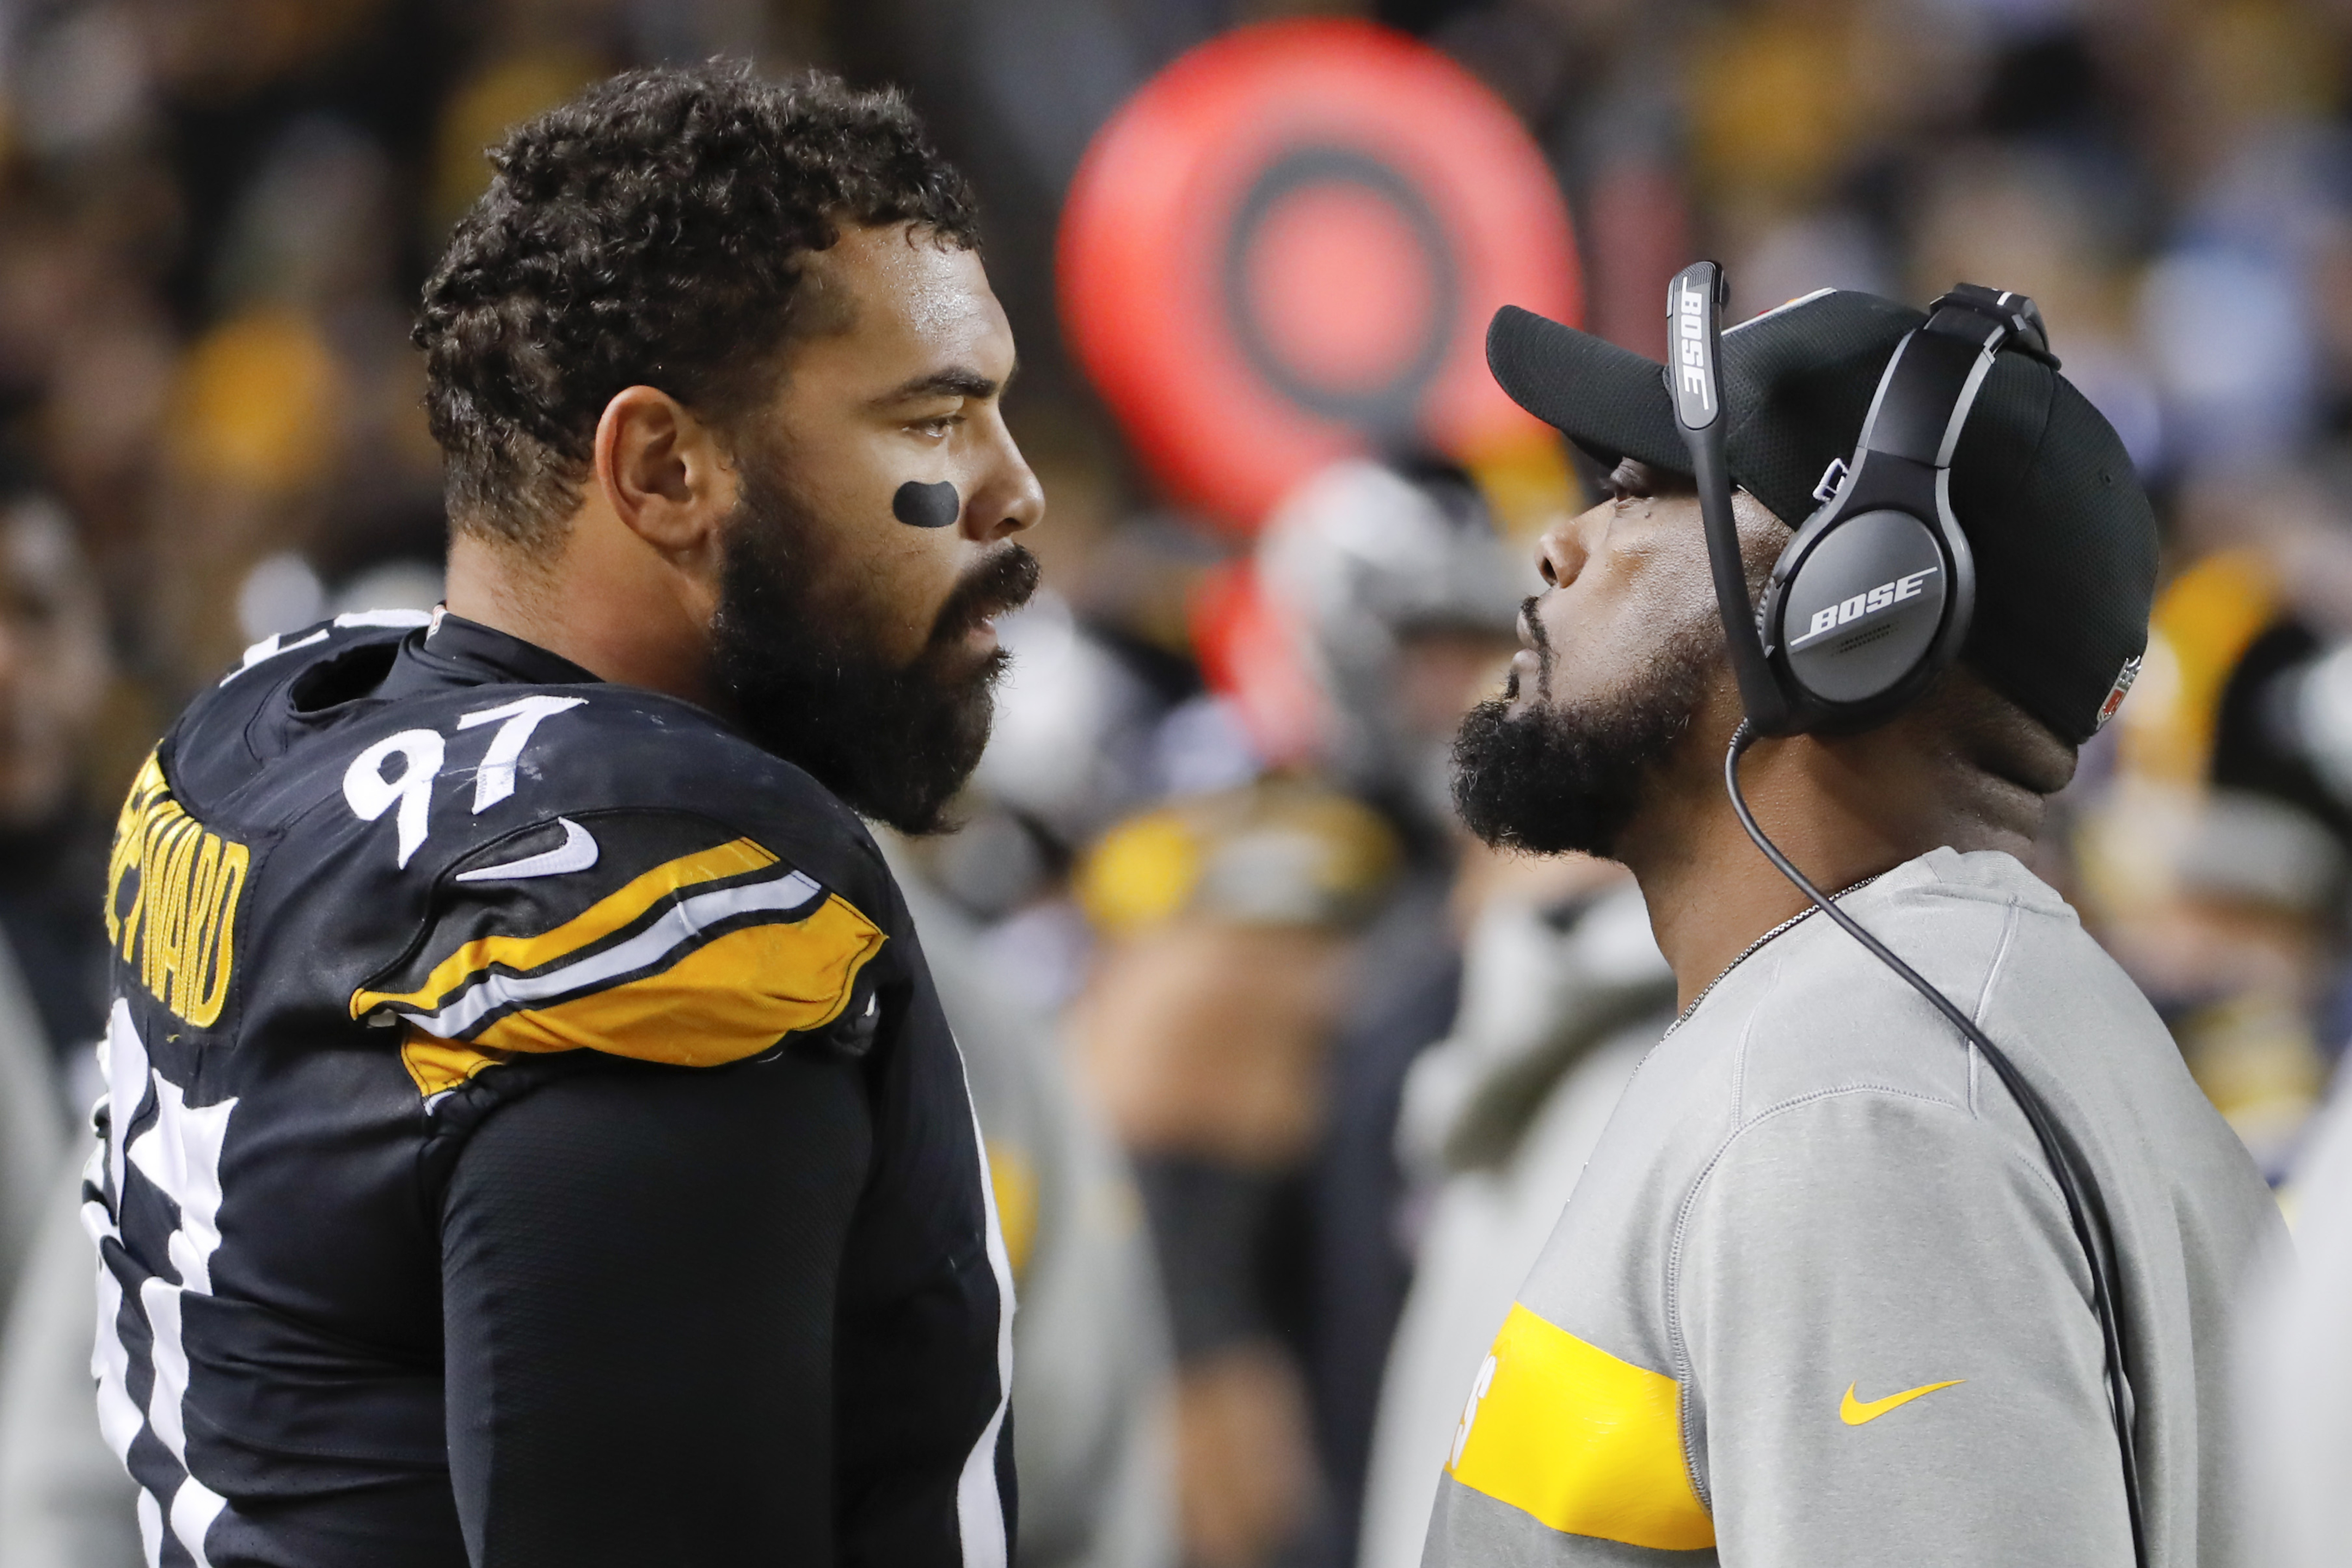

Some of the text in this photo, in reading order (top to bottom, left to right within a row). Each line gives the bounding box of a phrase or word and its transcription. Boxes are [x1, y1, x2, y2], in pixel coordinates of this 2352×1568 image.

[1681, 276, 1710, 410] BOSE
[1790, 566, 1938, 646] BOSE
[342, 695, 588, 870] 97
